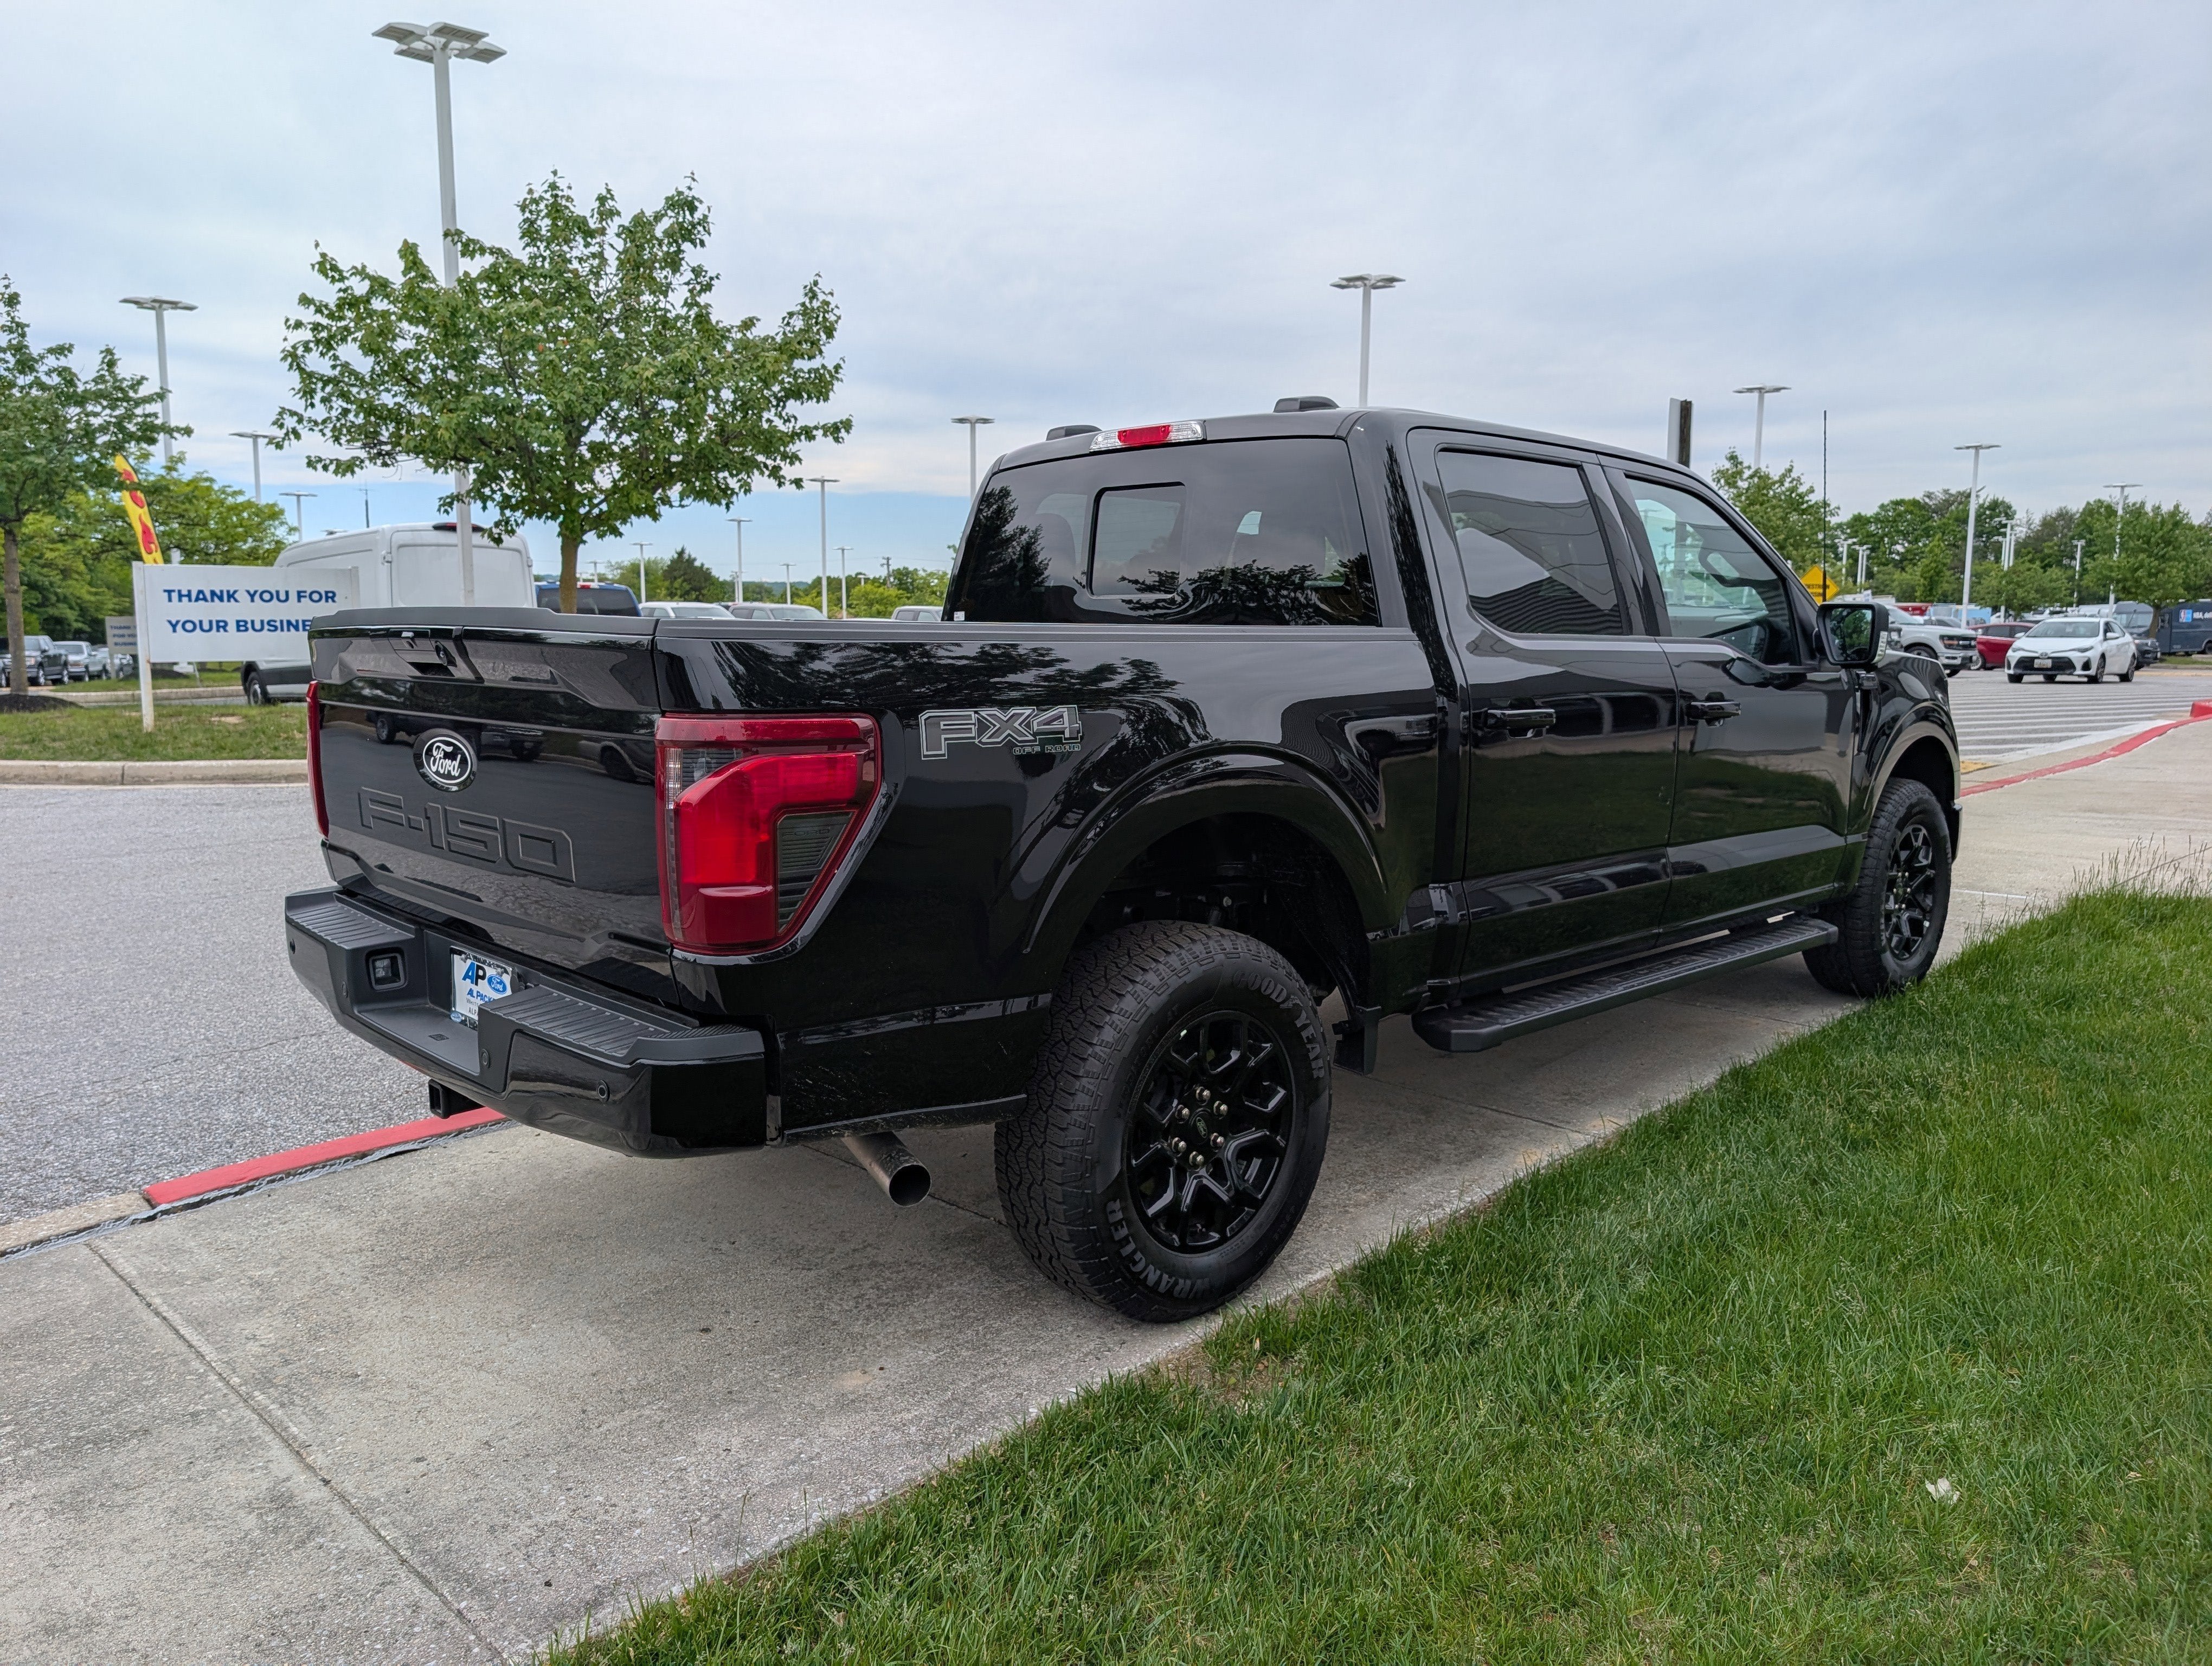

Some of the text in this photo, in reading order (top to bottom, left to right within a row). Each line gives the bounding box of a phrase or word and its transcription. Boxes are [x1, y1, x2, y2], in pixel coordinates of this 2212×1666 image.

[163, 589, 337, 603] THANK YOU FOR
[166, 619, 229, 633] YOUR
[919, 705, 1082, 760] FX4
[430, 742, 461, 777] Ford
[1012, 744, 1081, 755] OFF ROAD
[358, 786, 576, 883] F-150
[462, 961, 487, 986] AP
[466, 988, 496, 1003] AL PACK
[1232, 970, 1325, 1079] GOODYEAR
